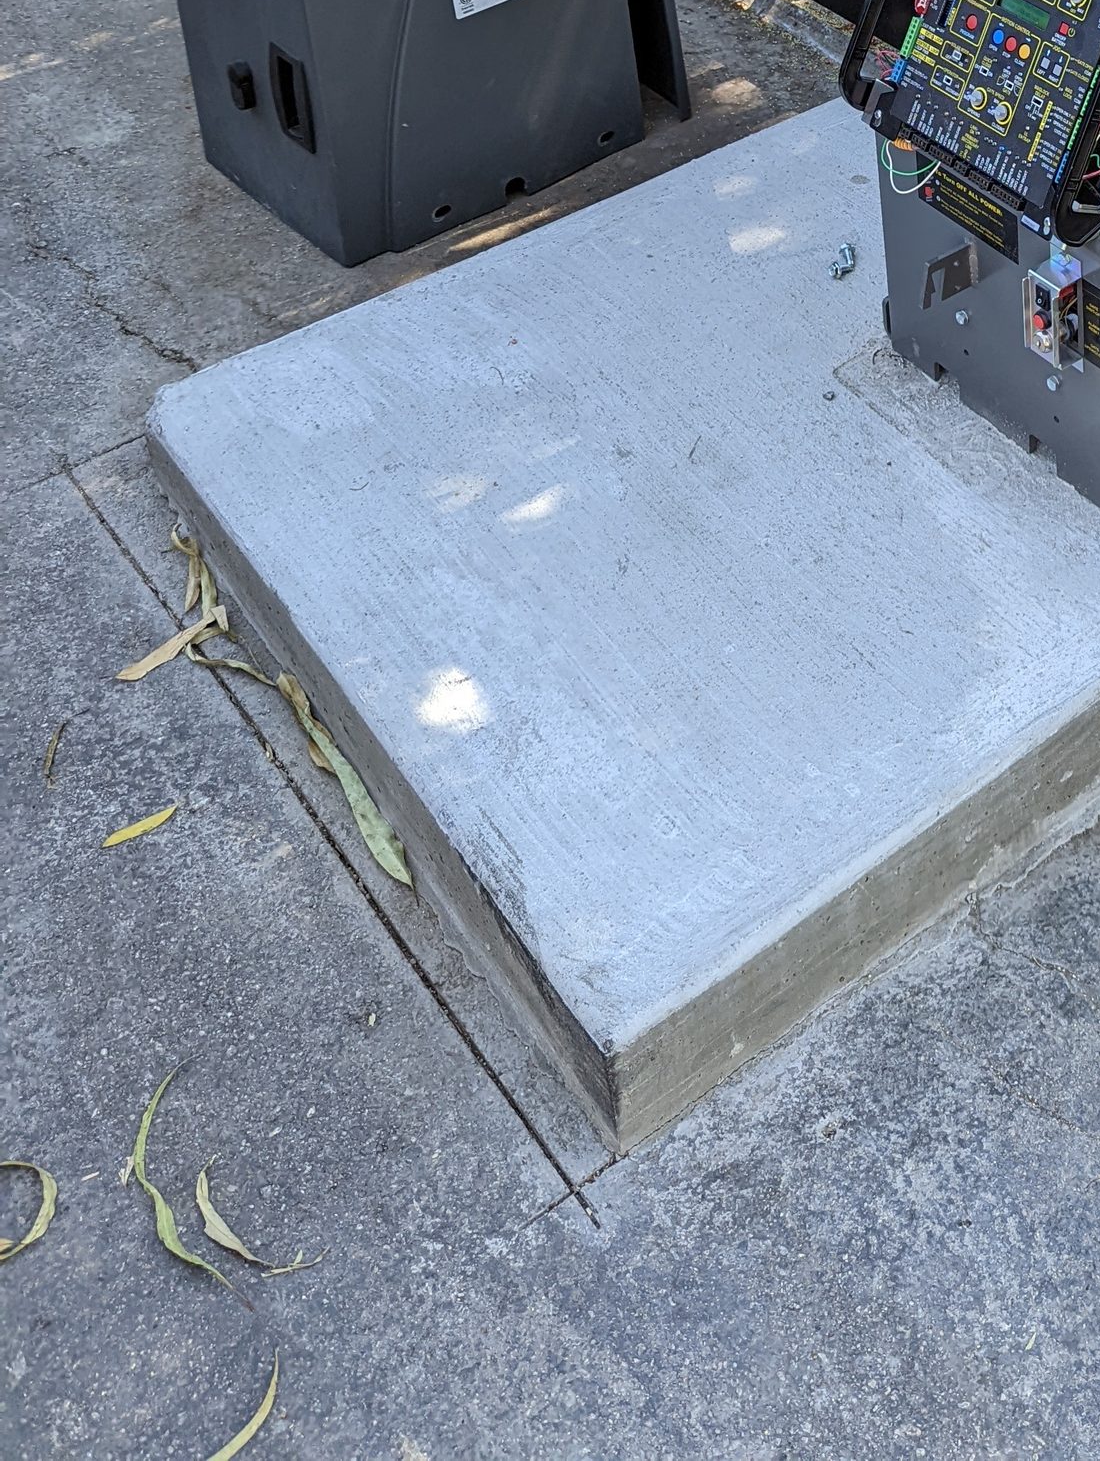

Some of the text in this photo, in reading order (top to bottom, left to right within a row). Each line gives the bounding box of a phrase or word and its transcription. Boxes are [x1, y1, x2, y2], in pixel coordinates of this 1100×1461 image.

[978, 158, 986, 169] STOP
[956, 183, 967, 193] OFF
[968, 190, 980, 201] ALL
